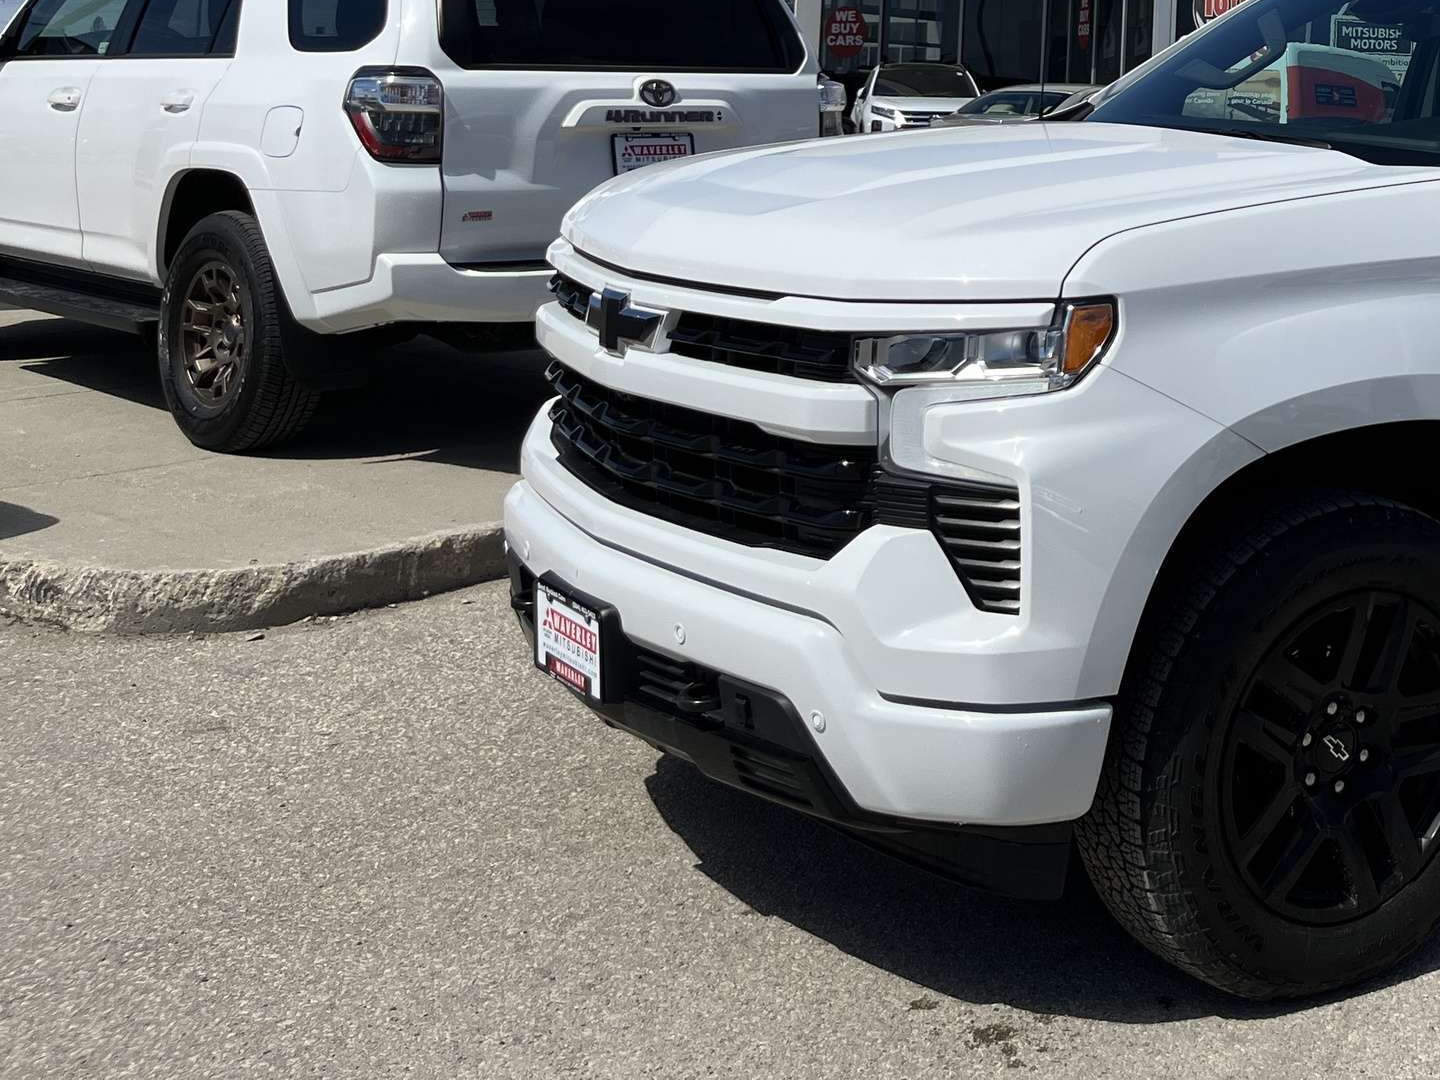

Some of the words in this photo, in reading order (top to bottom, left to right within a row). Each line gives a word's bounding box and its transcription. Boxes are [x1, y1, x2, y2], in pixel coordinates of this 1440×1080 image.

[835, 10, 857, 22] WE
[831, 23, 860, 34] BUY
[1342, 25, 1403, 39] MITSUBISH
[827, 35, 865, 46] CARS
[1350, 38, 1398, 51] MOTORS
[633, 145, 687, 156] WAVERLEY
[551, 610, 598, 653] WAVERLEY
[555, 660, 586, 688] WAVERLEY
